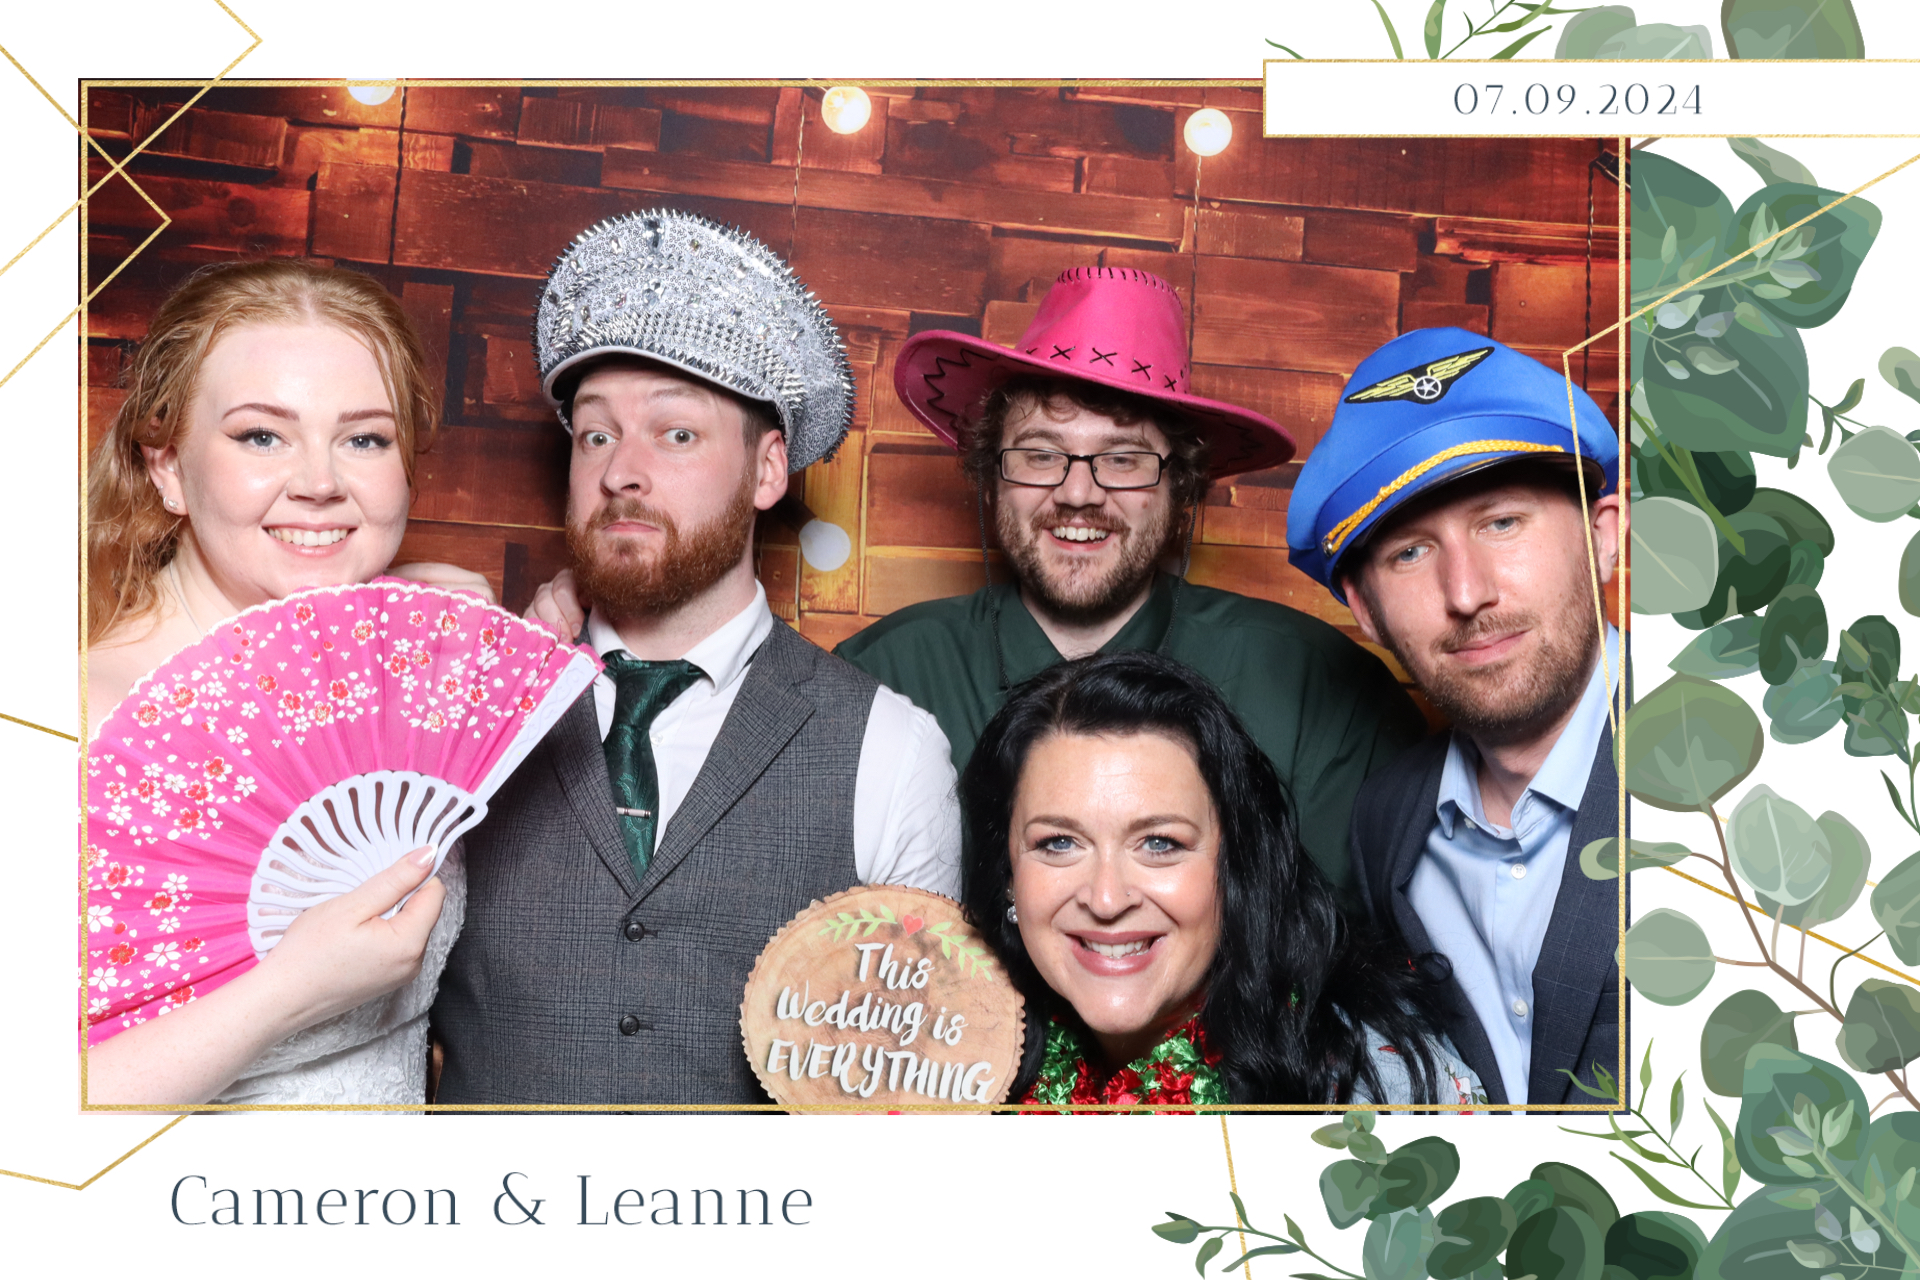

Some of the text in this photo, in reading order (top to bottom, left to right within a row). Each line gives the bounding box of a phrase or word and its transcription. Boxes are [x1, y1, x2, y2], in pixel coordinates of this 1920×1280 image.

[855, 942, 935, 990] This
[776, 980, 968, 1046] Wedding is
[766, 1038, 996, 1104] EVERYTHING
